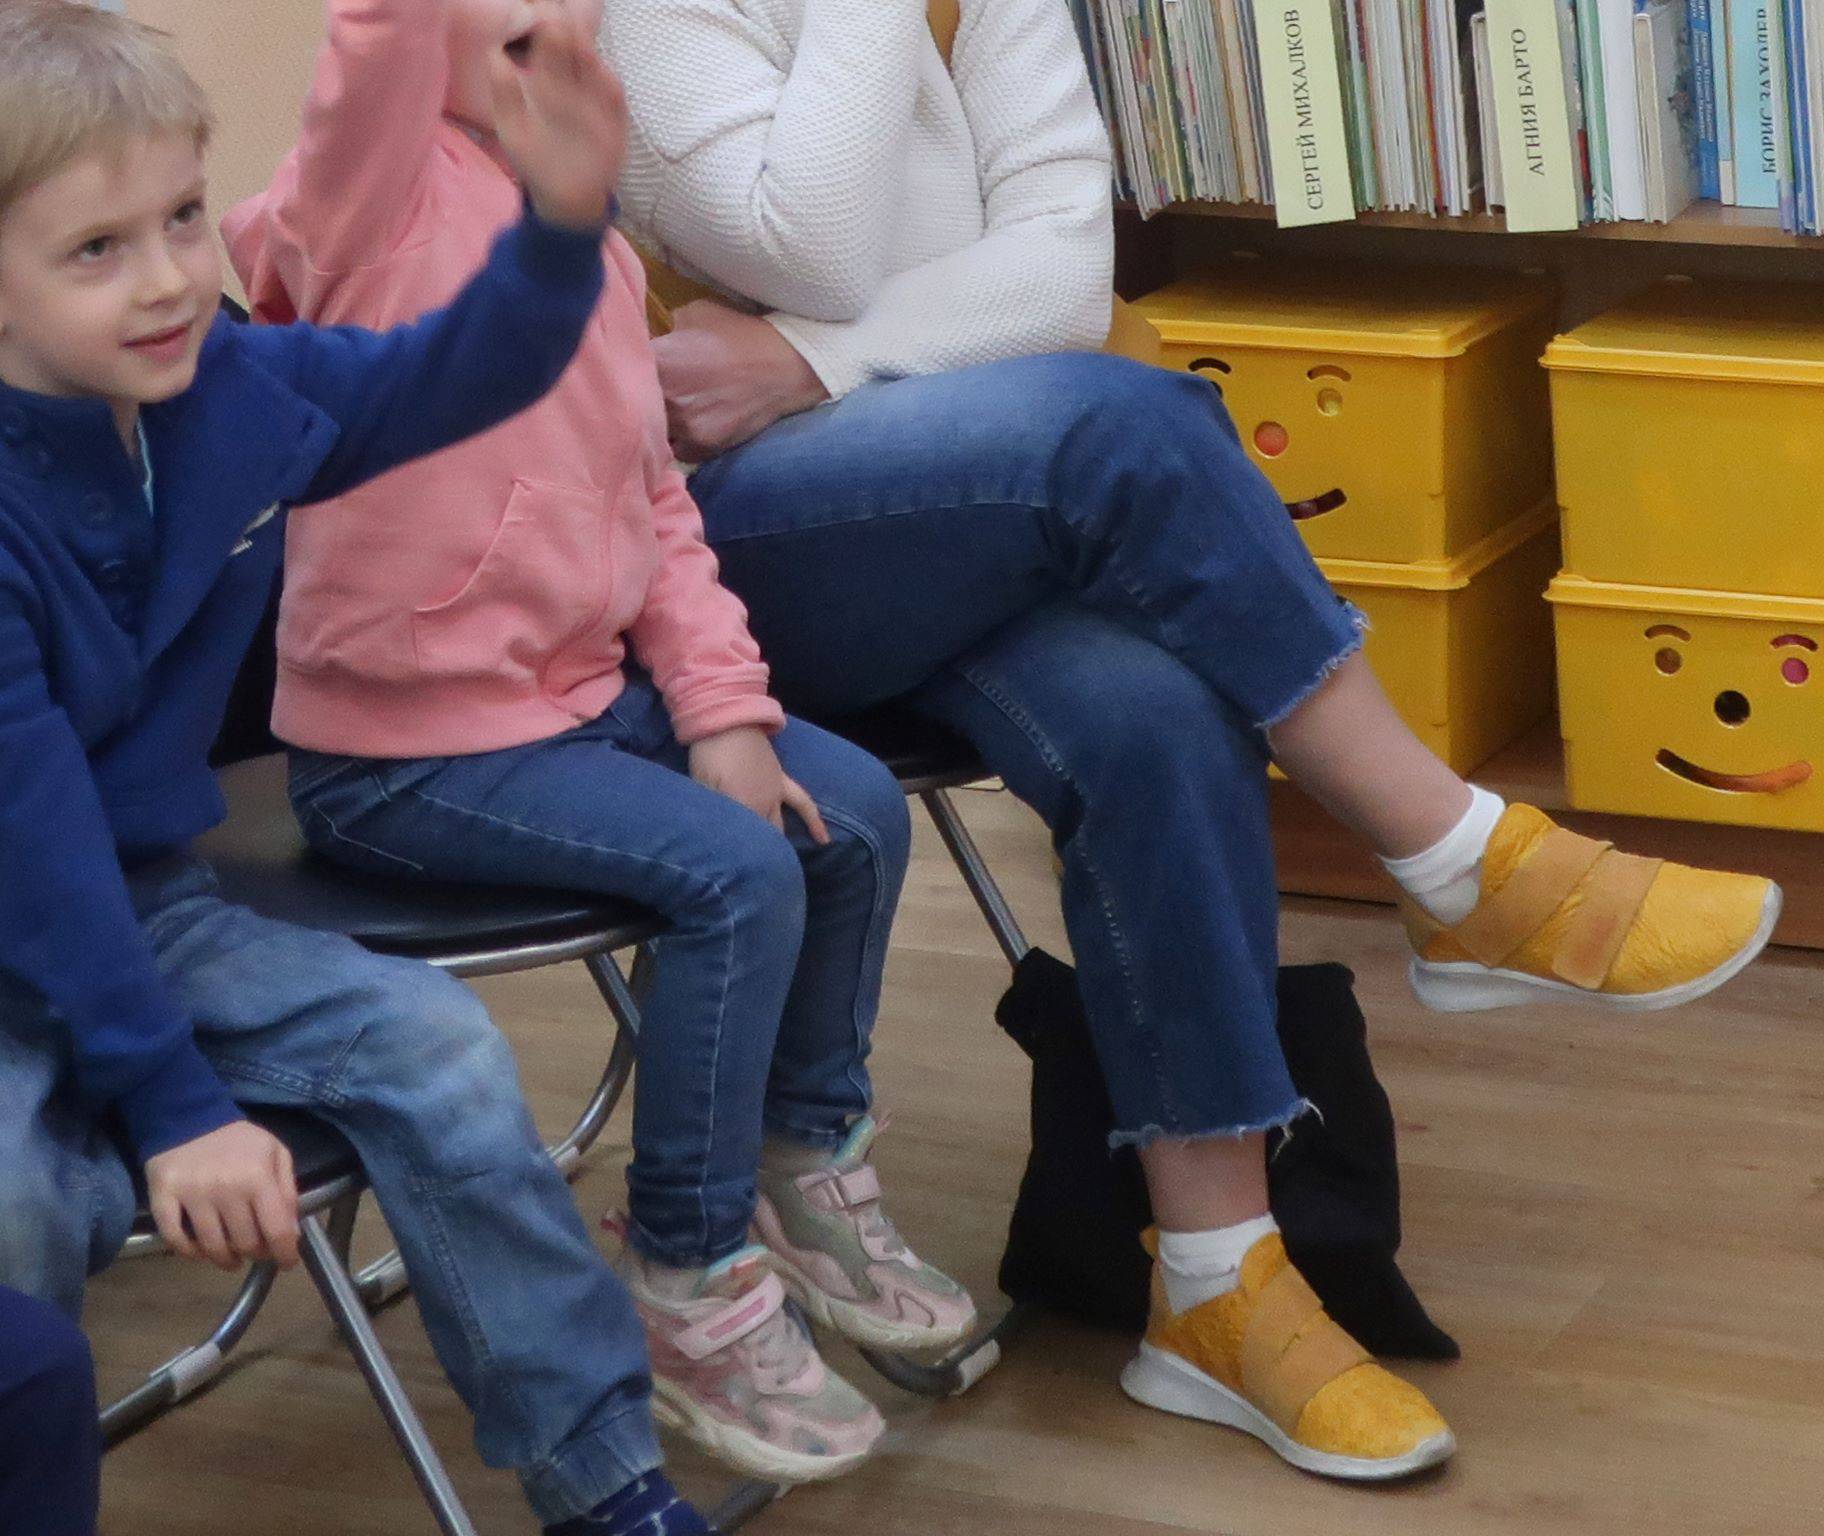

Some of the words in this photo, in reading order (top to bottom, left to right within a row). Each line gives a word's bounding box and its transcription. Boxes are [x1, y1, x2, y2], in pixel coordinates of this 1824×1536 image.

[1284, 9, 1313, 128] МИХАЛКОВ
[1511, 28, 1534, 97] БАРТО
[1295, 133, 1324, 211] СЕРГЕЙ
[1519, 104, 1545, 176] АГНИЯ
[1760, 107, 1775, 173] БОРИС
